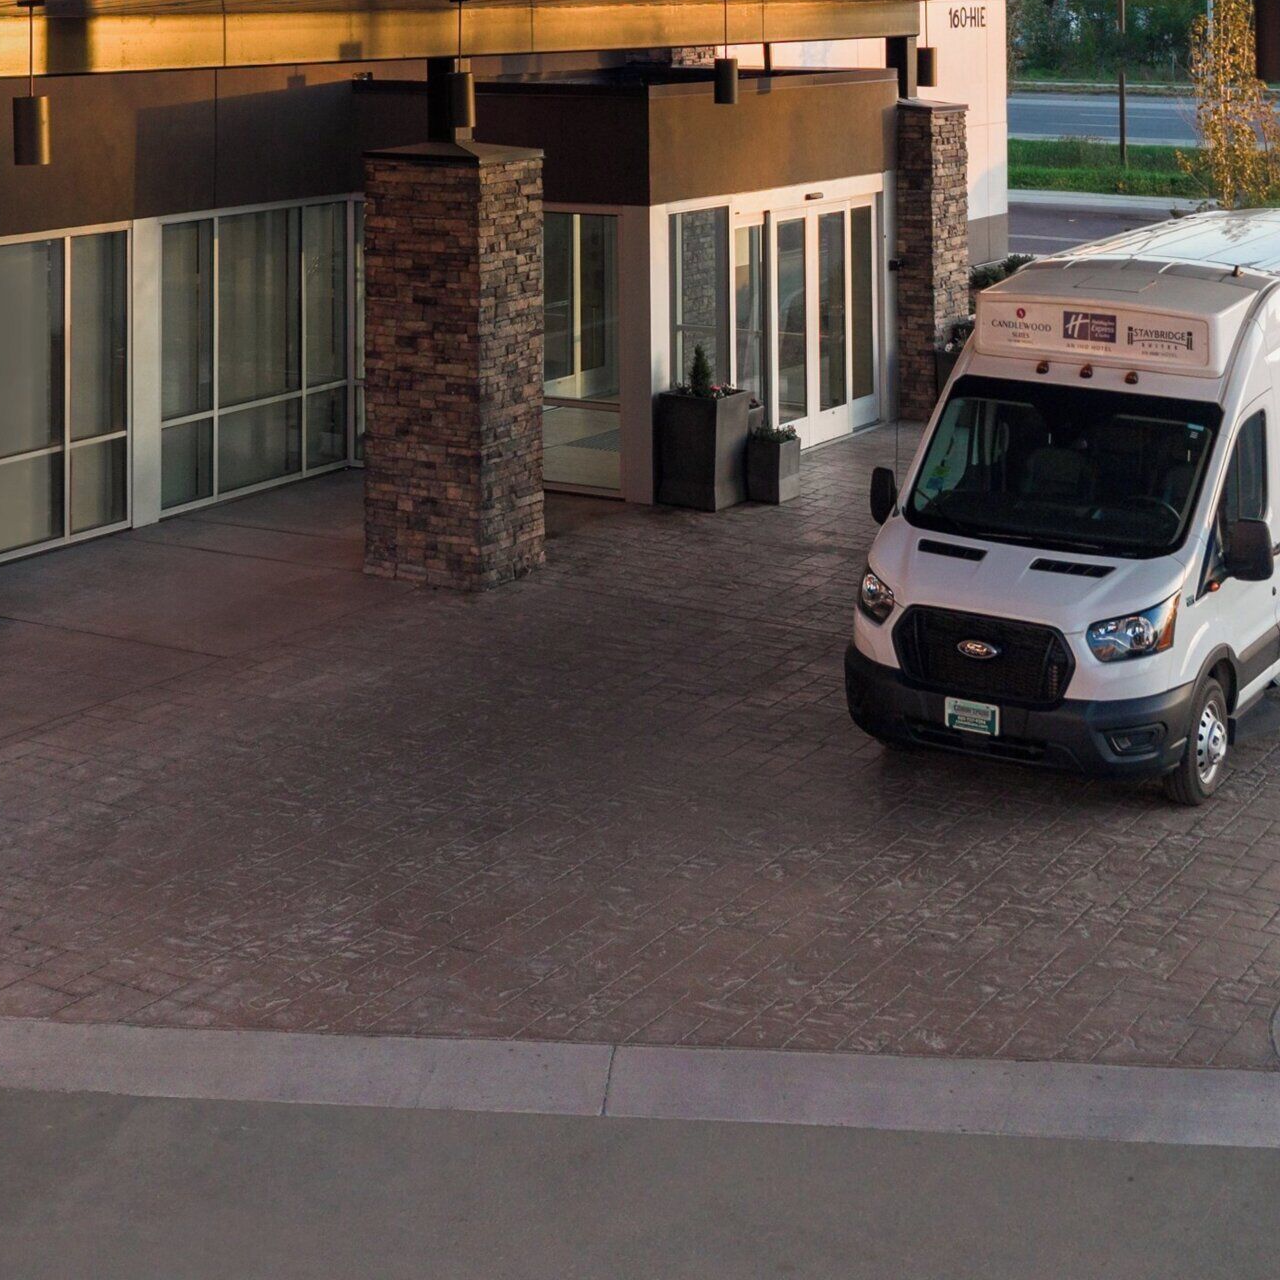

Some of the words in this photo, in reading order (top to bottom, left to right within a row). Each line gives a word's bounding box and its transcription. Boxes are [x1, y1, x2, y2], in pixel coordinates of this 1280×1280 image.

[949, 6, 986, 28] 160-HIE
[991, 319, 1052, 332] CANDLEWOOD
[1133, 328, 1186, 341] STAYBRIDGE
